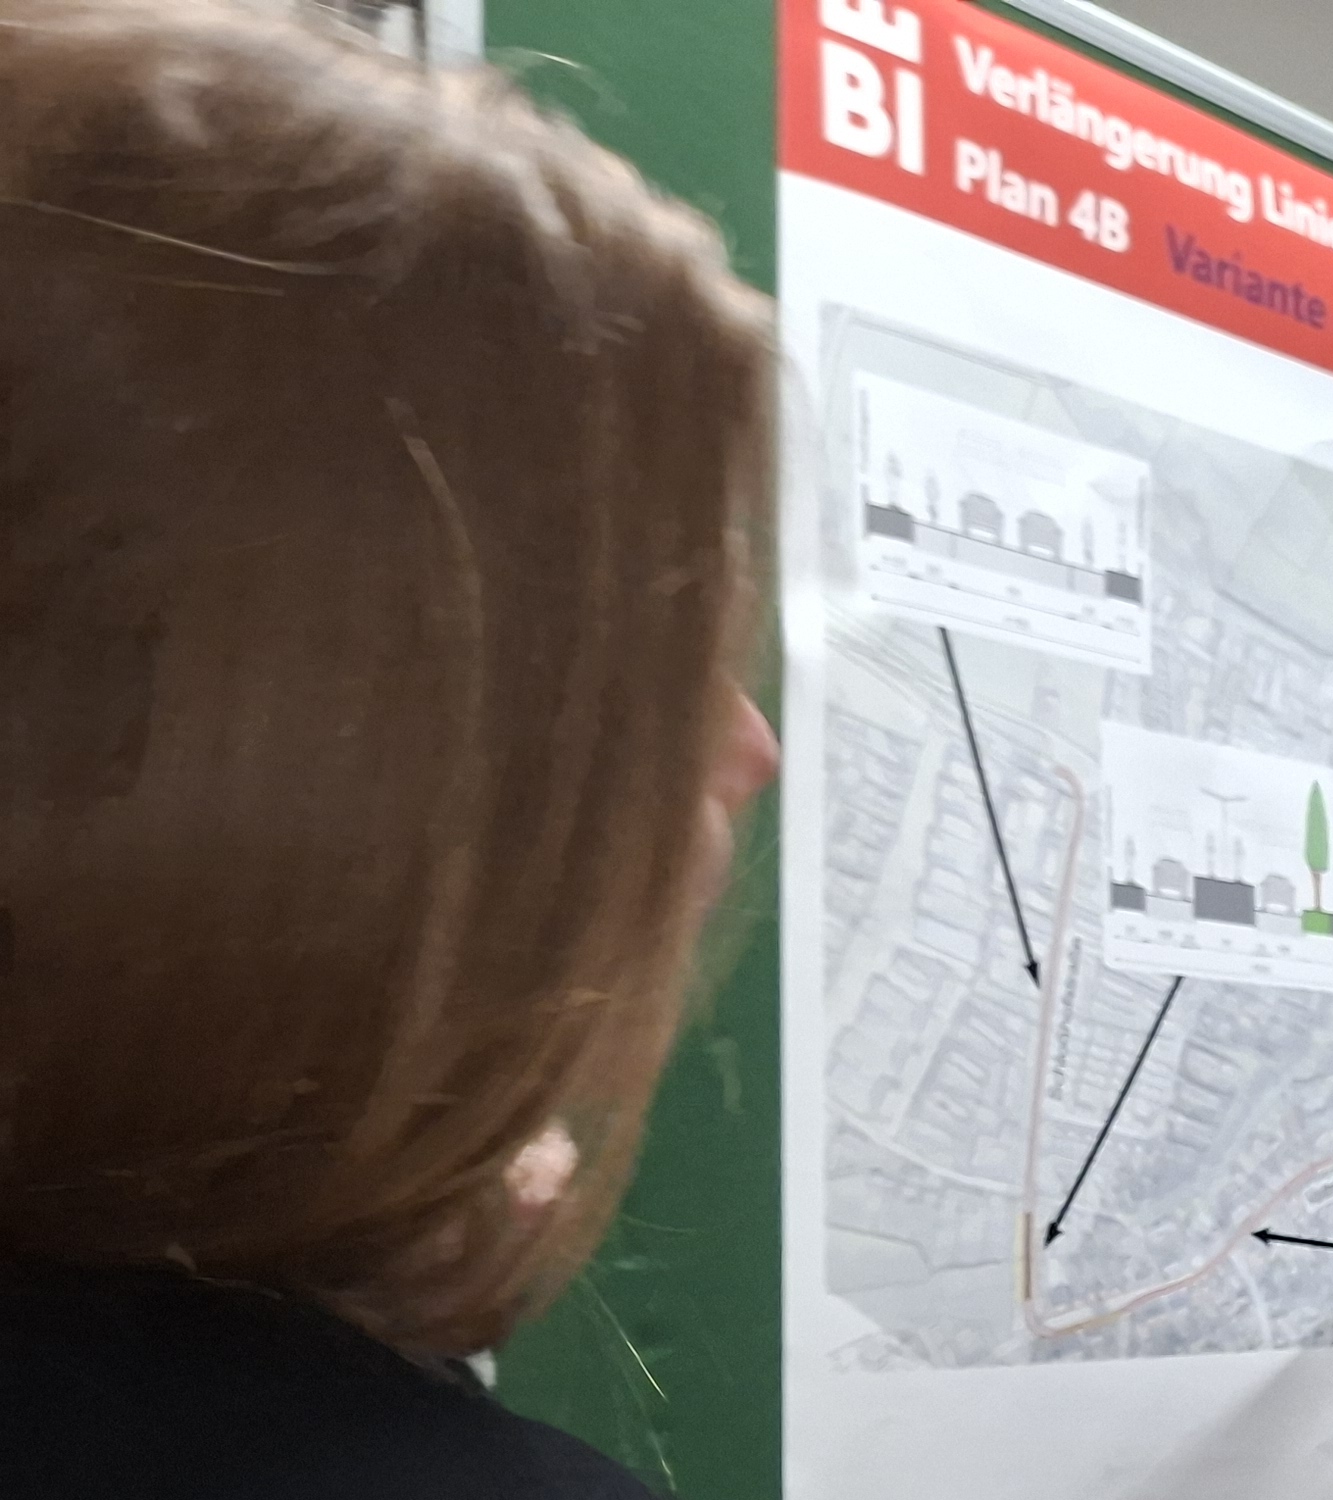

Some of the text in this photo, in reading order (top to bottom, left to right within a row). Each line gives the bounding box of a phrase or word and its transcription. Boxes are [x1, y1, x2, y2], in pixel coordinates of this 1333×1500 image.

[820, 37, 925, 177] BI
[954, 33, 1253, 222] Verlängerung
[955, 137, 1130, 253] Plan 4B
[1165, 222, 1326, 330] Variante
